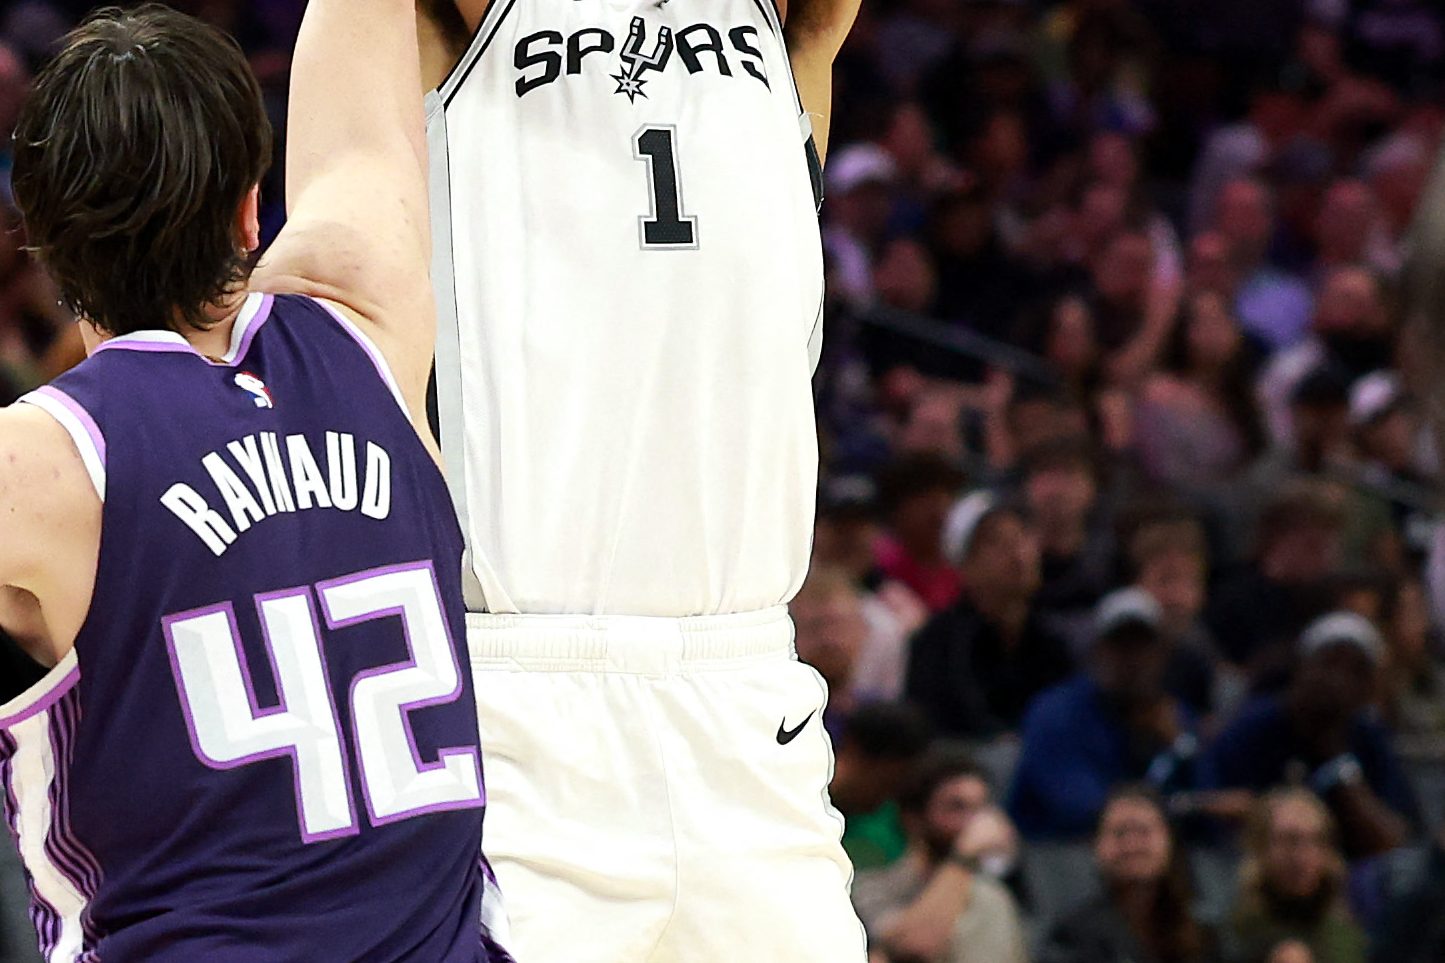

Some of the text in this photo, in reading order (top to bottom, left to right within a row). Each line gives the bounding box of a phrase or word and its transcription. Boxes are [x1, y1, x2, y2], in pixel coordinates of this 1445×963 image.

[514, 16, 772, 104] SPURS
[631, 123, 700, 251] 1
[160, 431, 391, 556] RAYNAUD
[161, 560, 486, 845] 42
